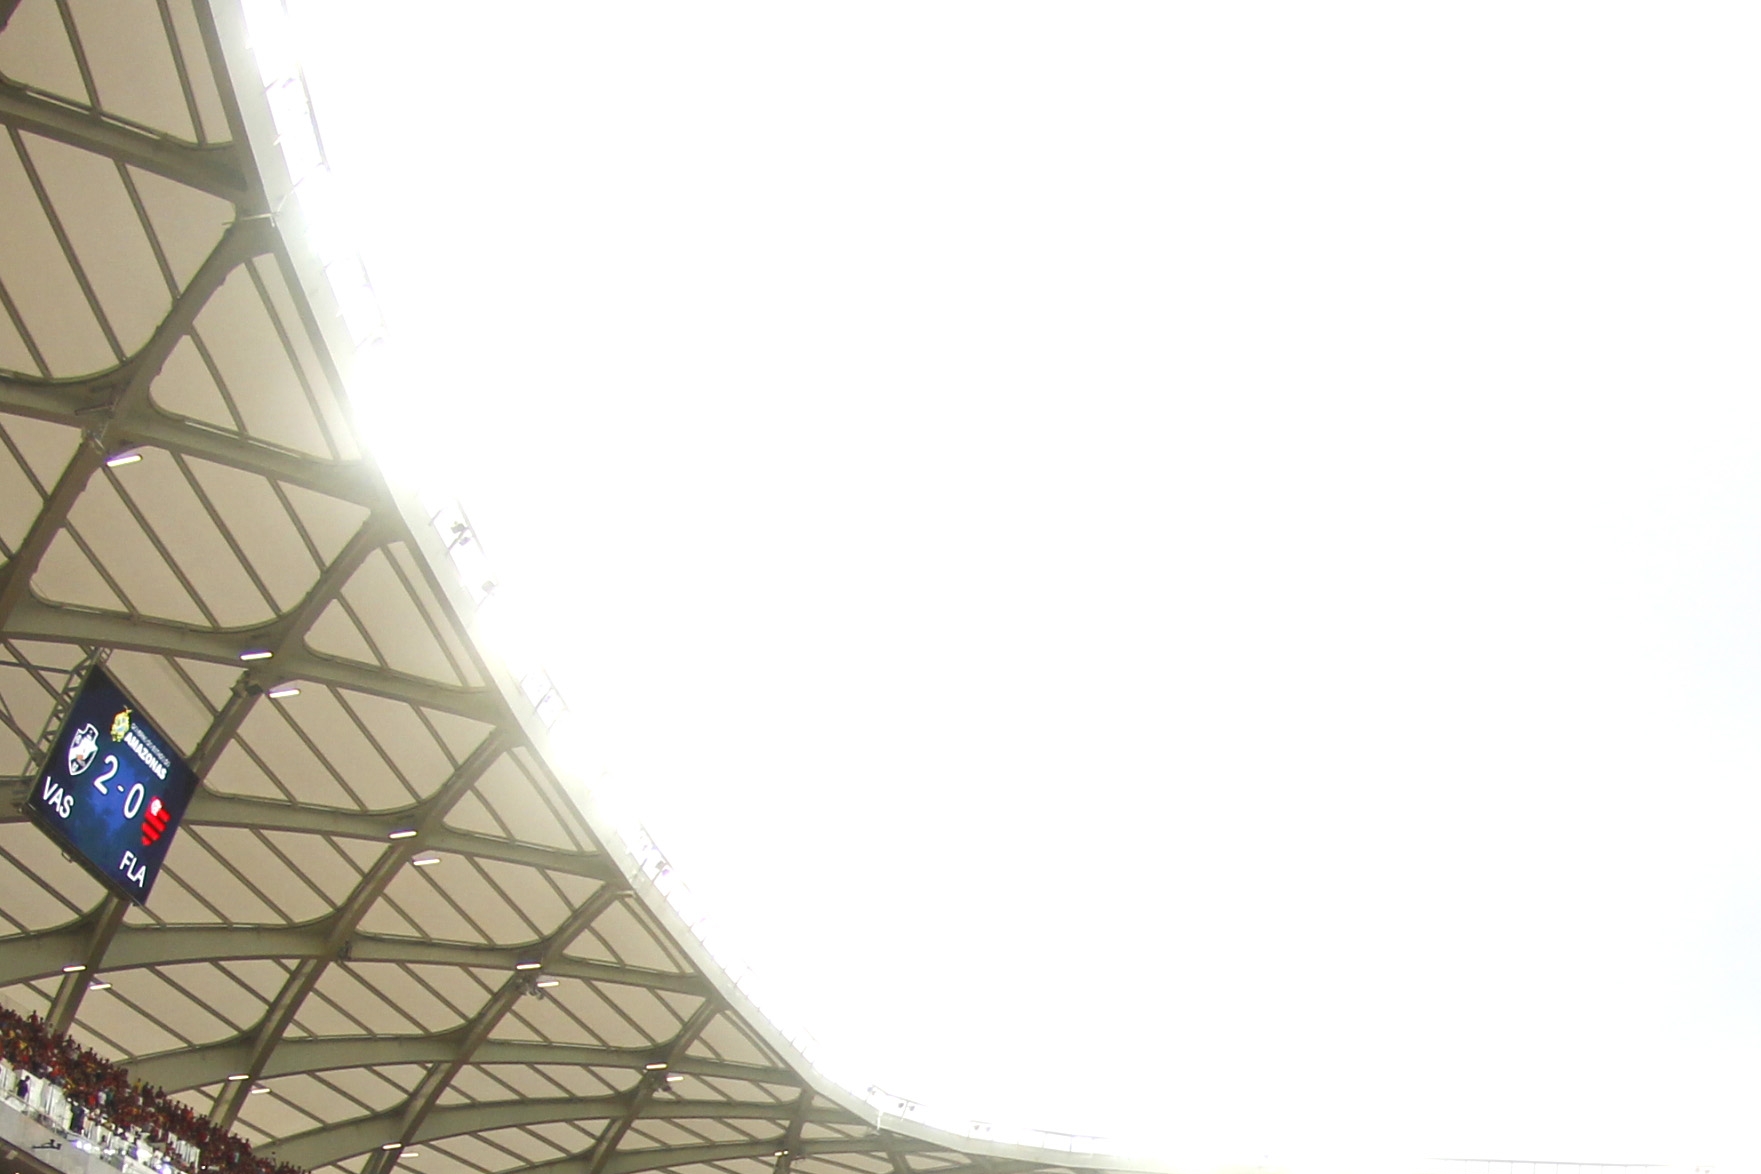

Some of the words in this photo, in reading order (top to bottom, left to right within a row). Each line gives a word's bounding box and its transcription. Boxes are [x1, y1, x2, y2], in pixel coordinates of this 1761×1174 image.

[124, 732, 167, 779] AMAZONAS
[43, 776, 75, 818] VAS
[119, 850, 147, 887] FLA
